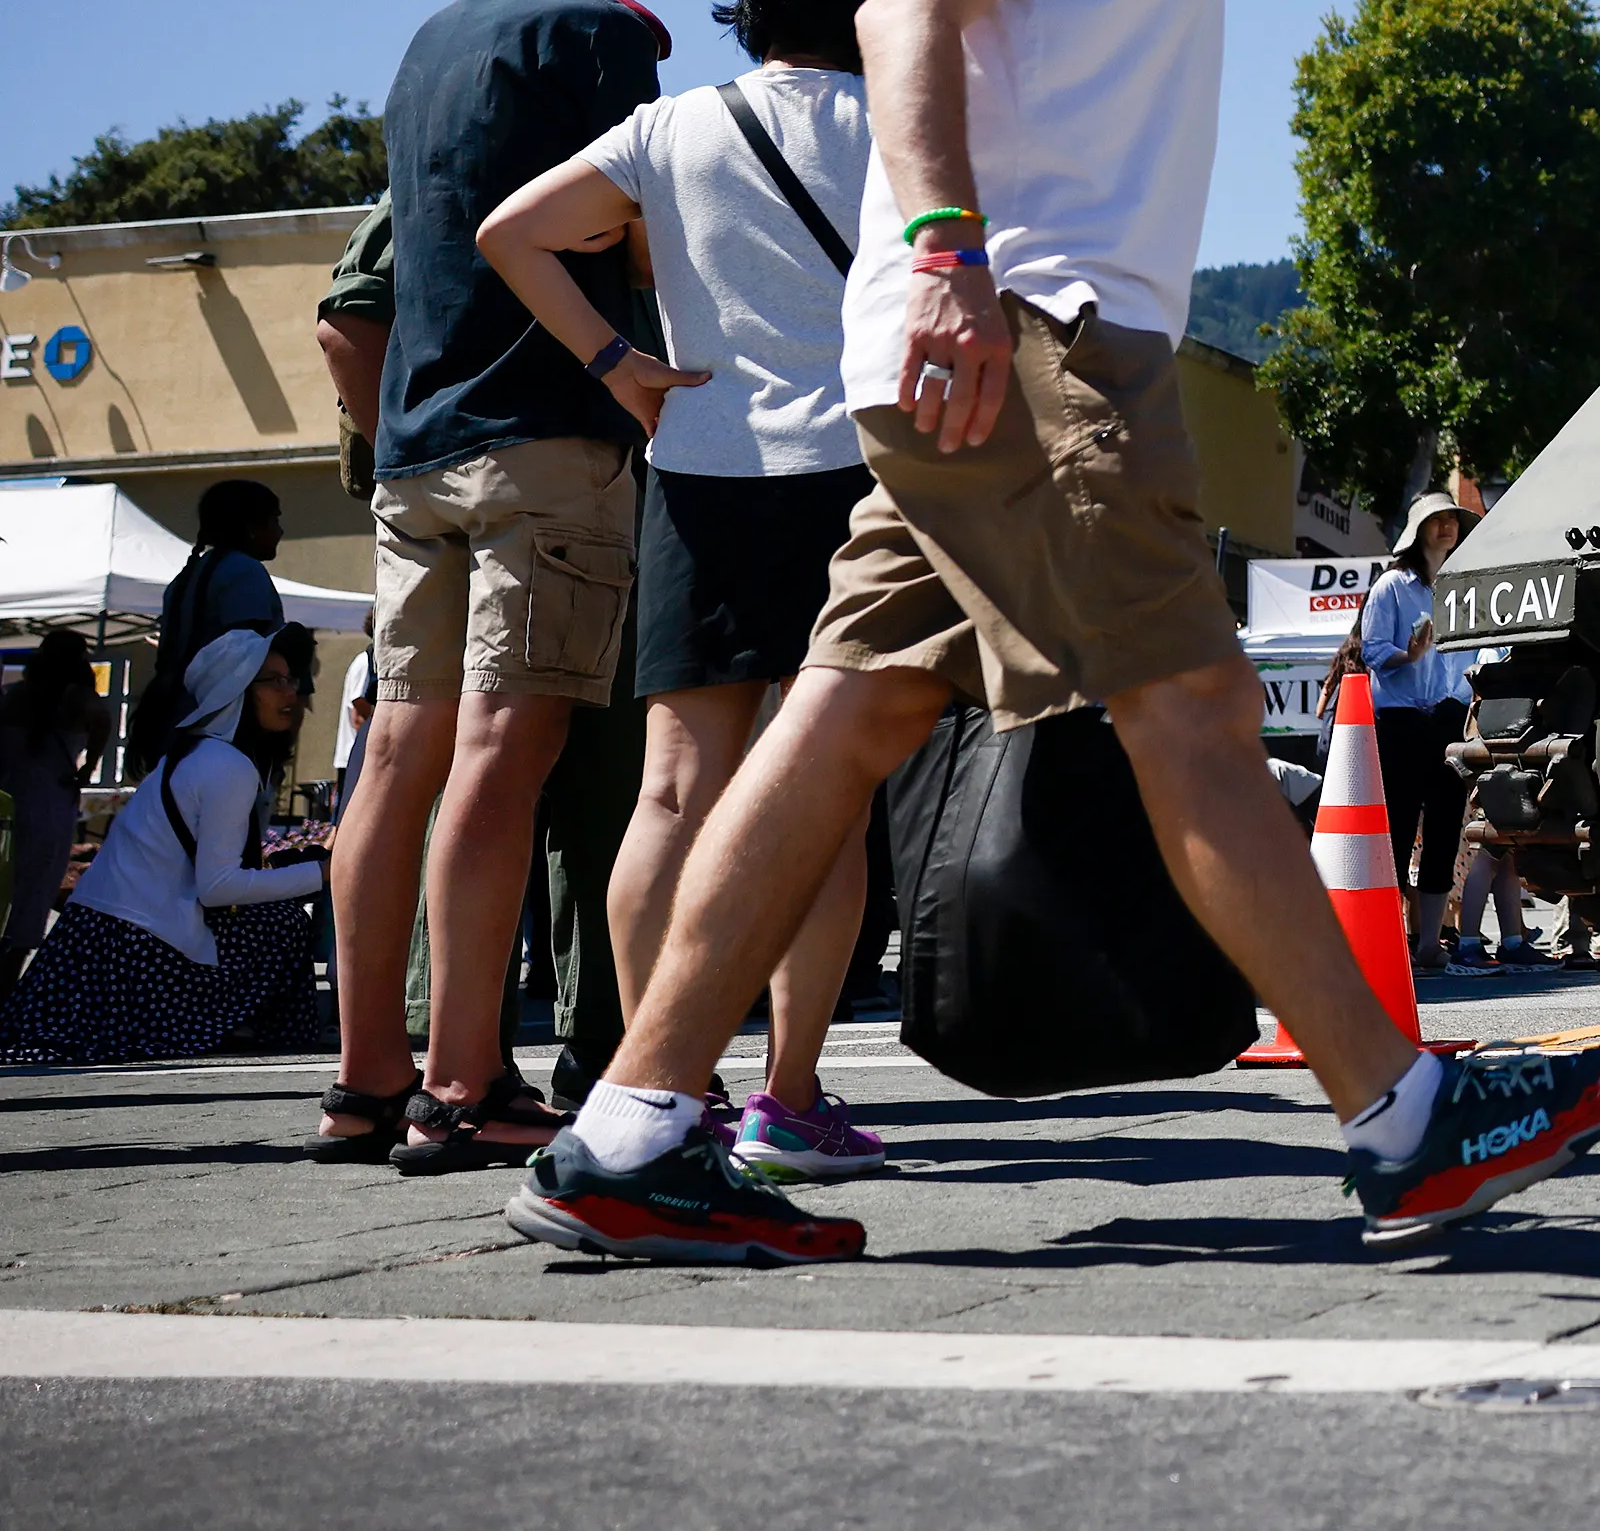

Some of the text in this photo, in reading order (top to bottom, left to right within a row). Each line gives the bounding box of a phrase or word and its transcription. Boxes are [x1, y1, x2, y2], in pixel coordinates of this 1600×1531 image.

[1311, 565, 1359, 591] De
[1312, 594, 1364, 611] CON
[1444, 574, 1565, 632] 11 CAV
[1461, 1107, 1551, 1166] HOKA
[648, 1192, 700, 1209] TORRENT
